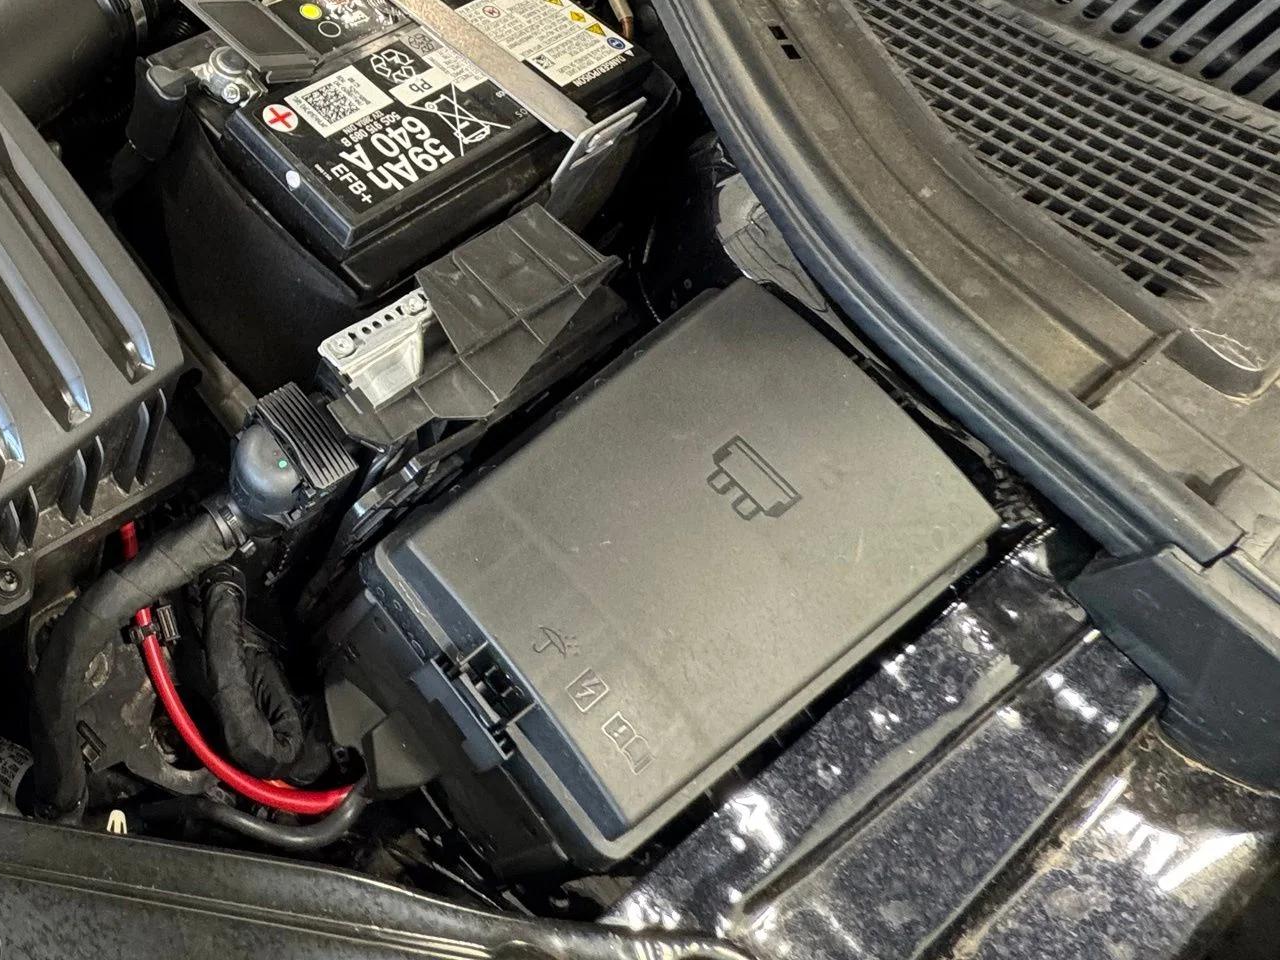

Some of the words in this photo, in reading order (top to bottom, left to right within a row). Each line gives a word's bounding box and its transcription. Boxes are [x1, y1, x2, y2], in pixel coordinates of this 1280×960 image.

[409, 79, 431, 94] Pb
[349, 128, 368, 142] 089
[365, 120, 383, 134] 915
[370, 115, 431, 157] 640
[341, 137, 352, 147] B
[338, 143, 370, 171] A
[367, 137, 453, 191] 59Ah
[329, 162, 372, 204] EFB+
